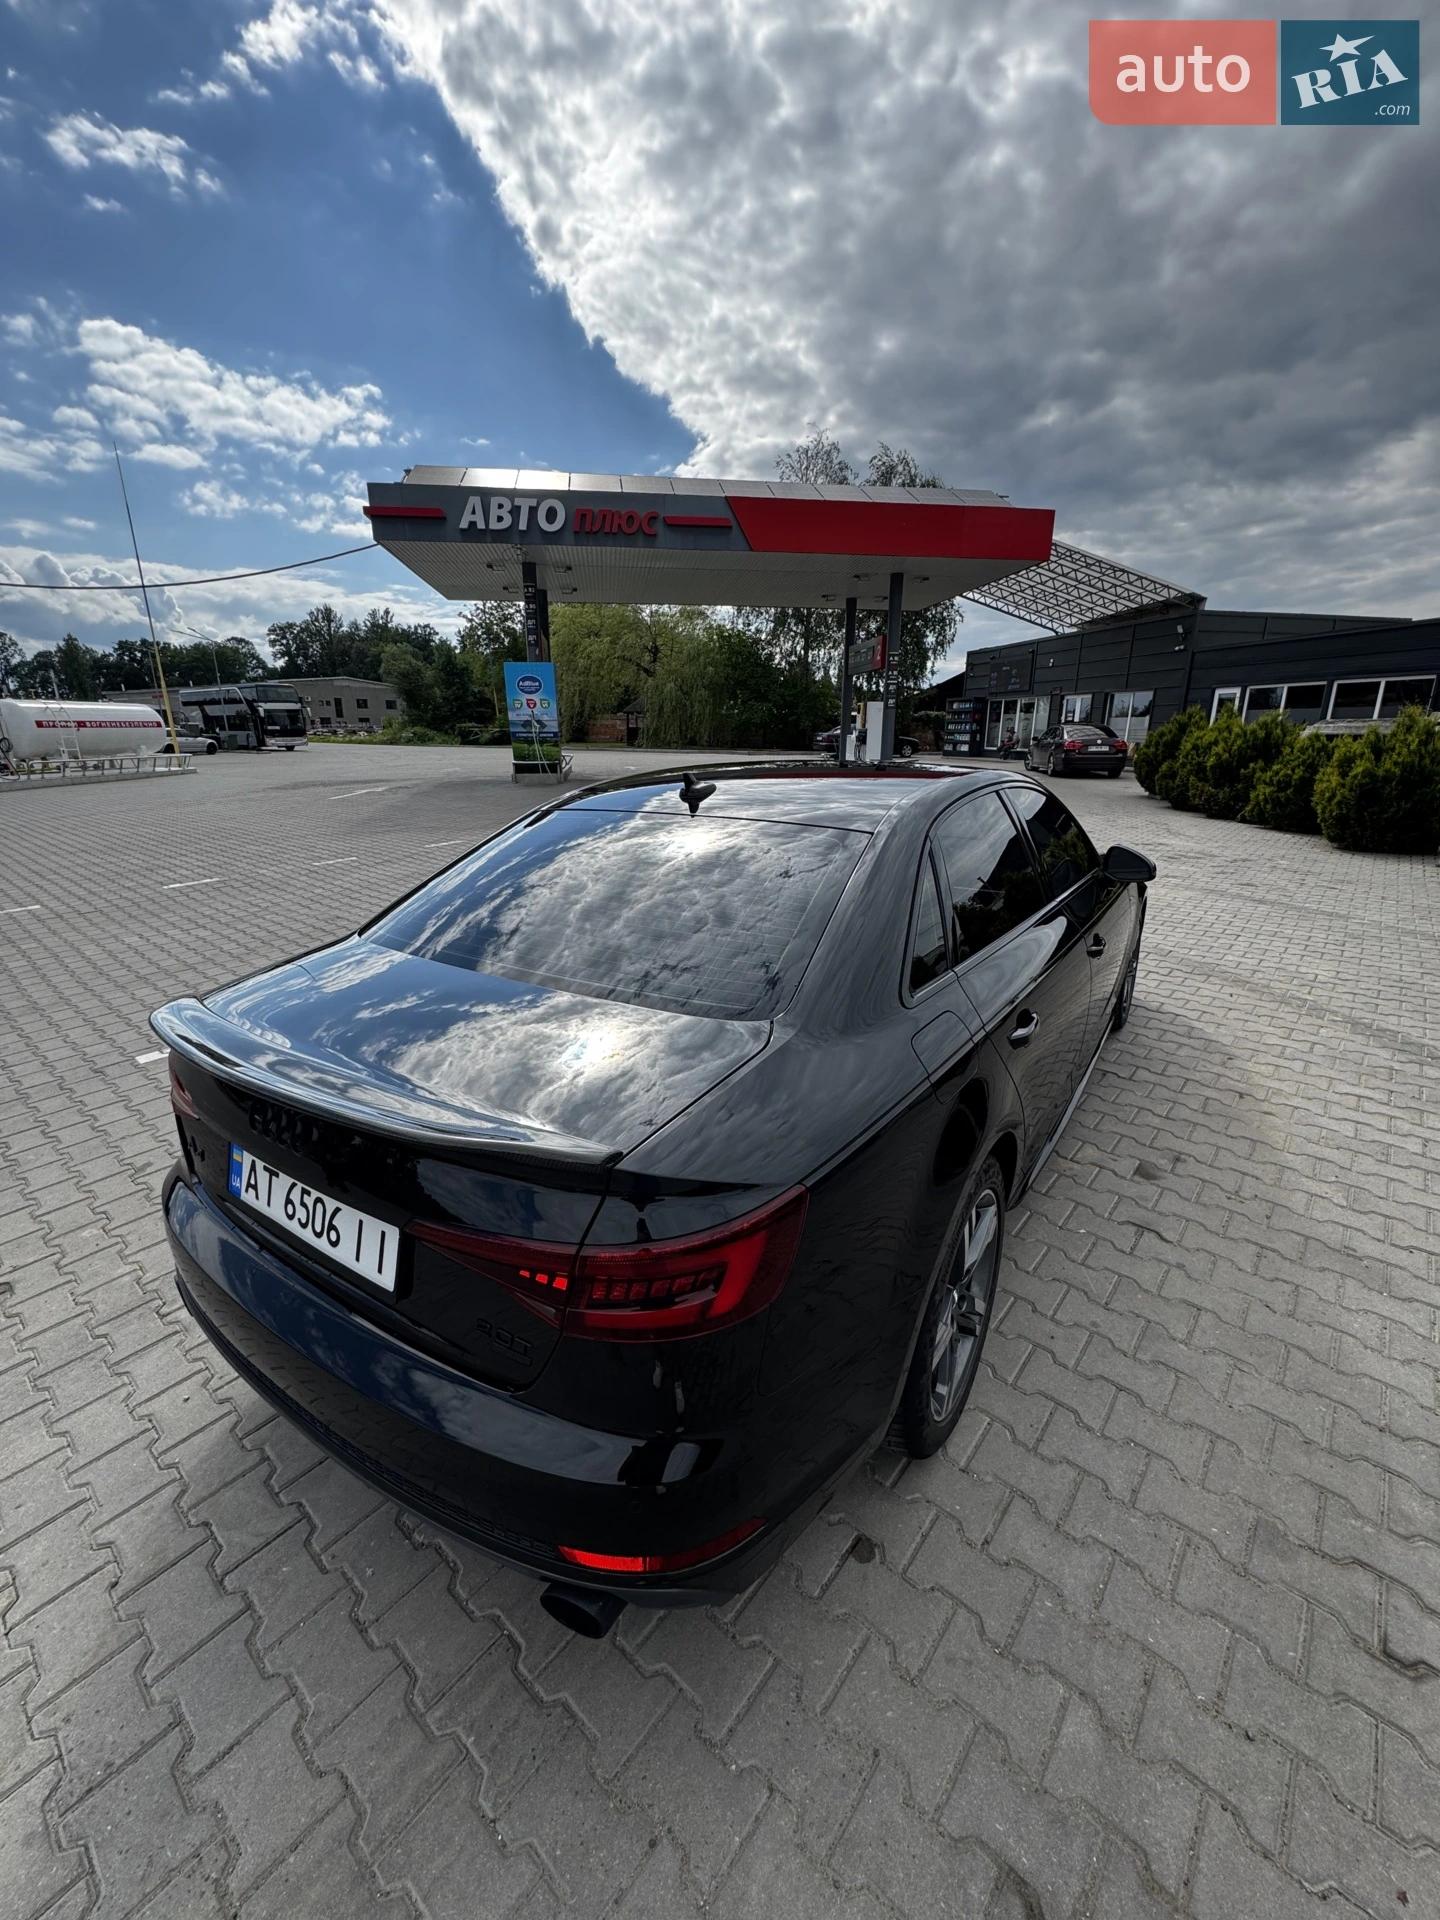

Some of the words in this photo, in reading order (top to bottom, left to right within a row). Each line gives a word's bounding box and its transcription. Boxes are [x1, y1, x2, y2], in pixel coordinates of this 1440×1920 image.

[458, 495, 566, 533] АВТО
[231, 1173, 241, 1188] UA
[245, 1159, 280, 1208] AT
[284, 1181, 342, 1249] 6506
